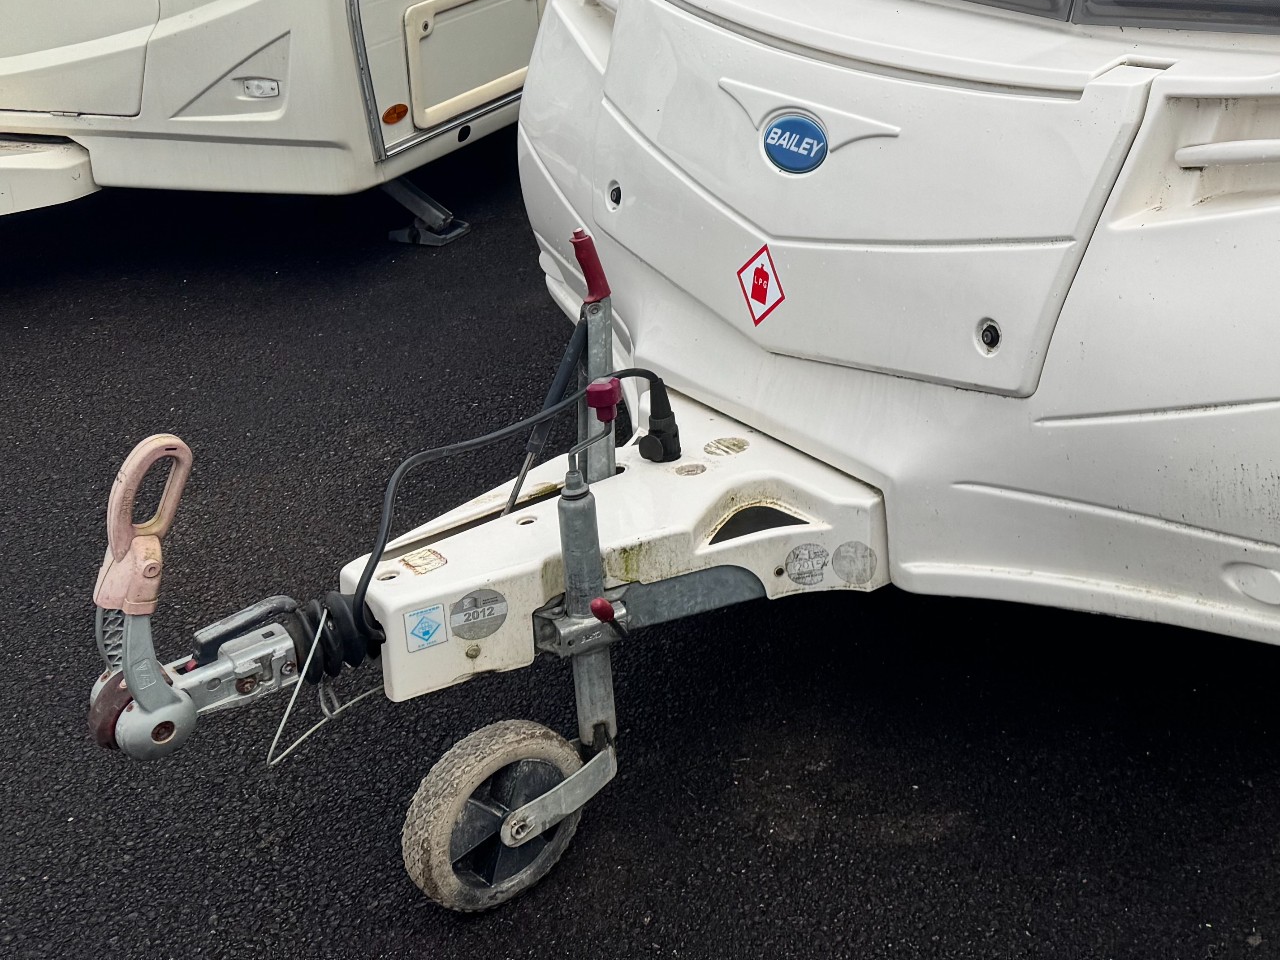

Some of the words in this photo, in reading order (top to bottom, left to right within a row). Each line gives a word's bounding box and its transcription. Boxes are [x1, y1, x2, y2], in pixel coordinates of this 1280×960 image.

[766, 127, 824, 158] BAILEY
[754, 275, 768, 289] LPG
[464, 606, 495, 622] 2012
